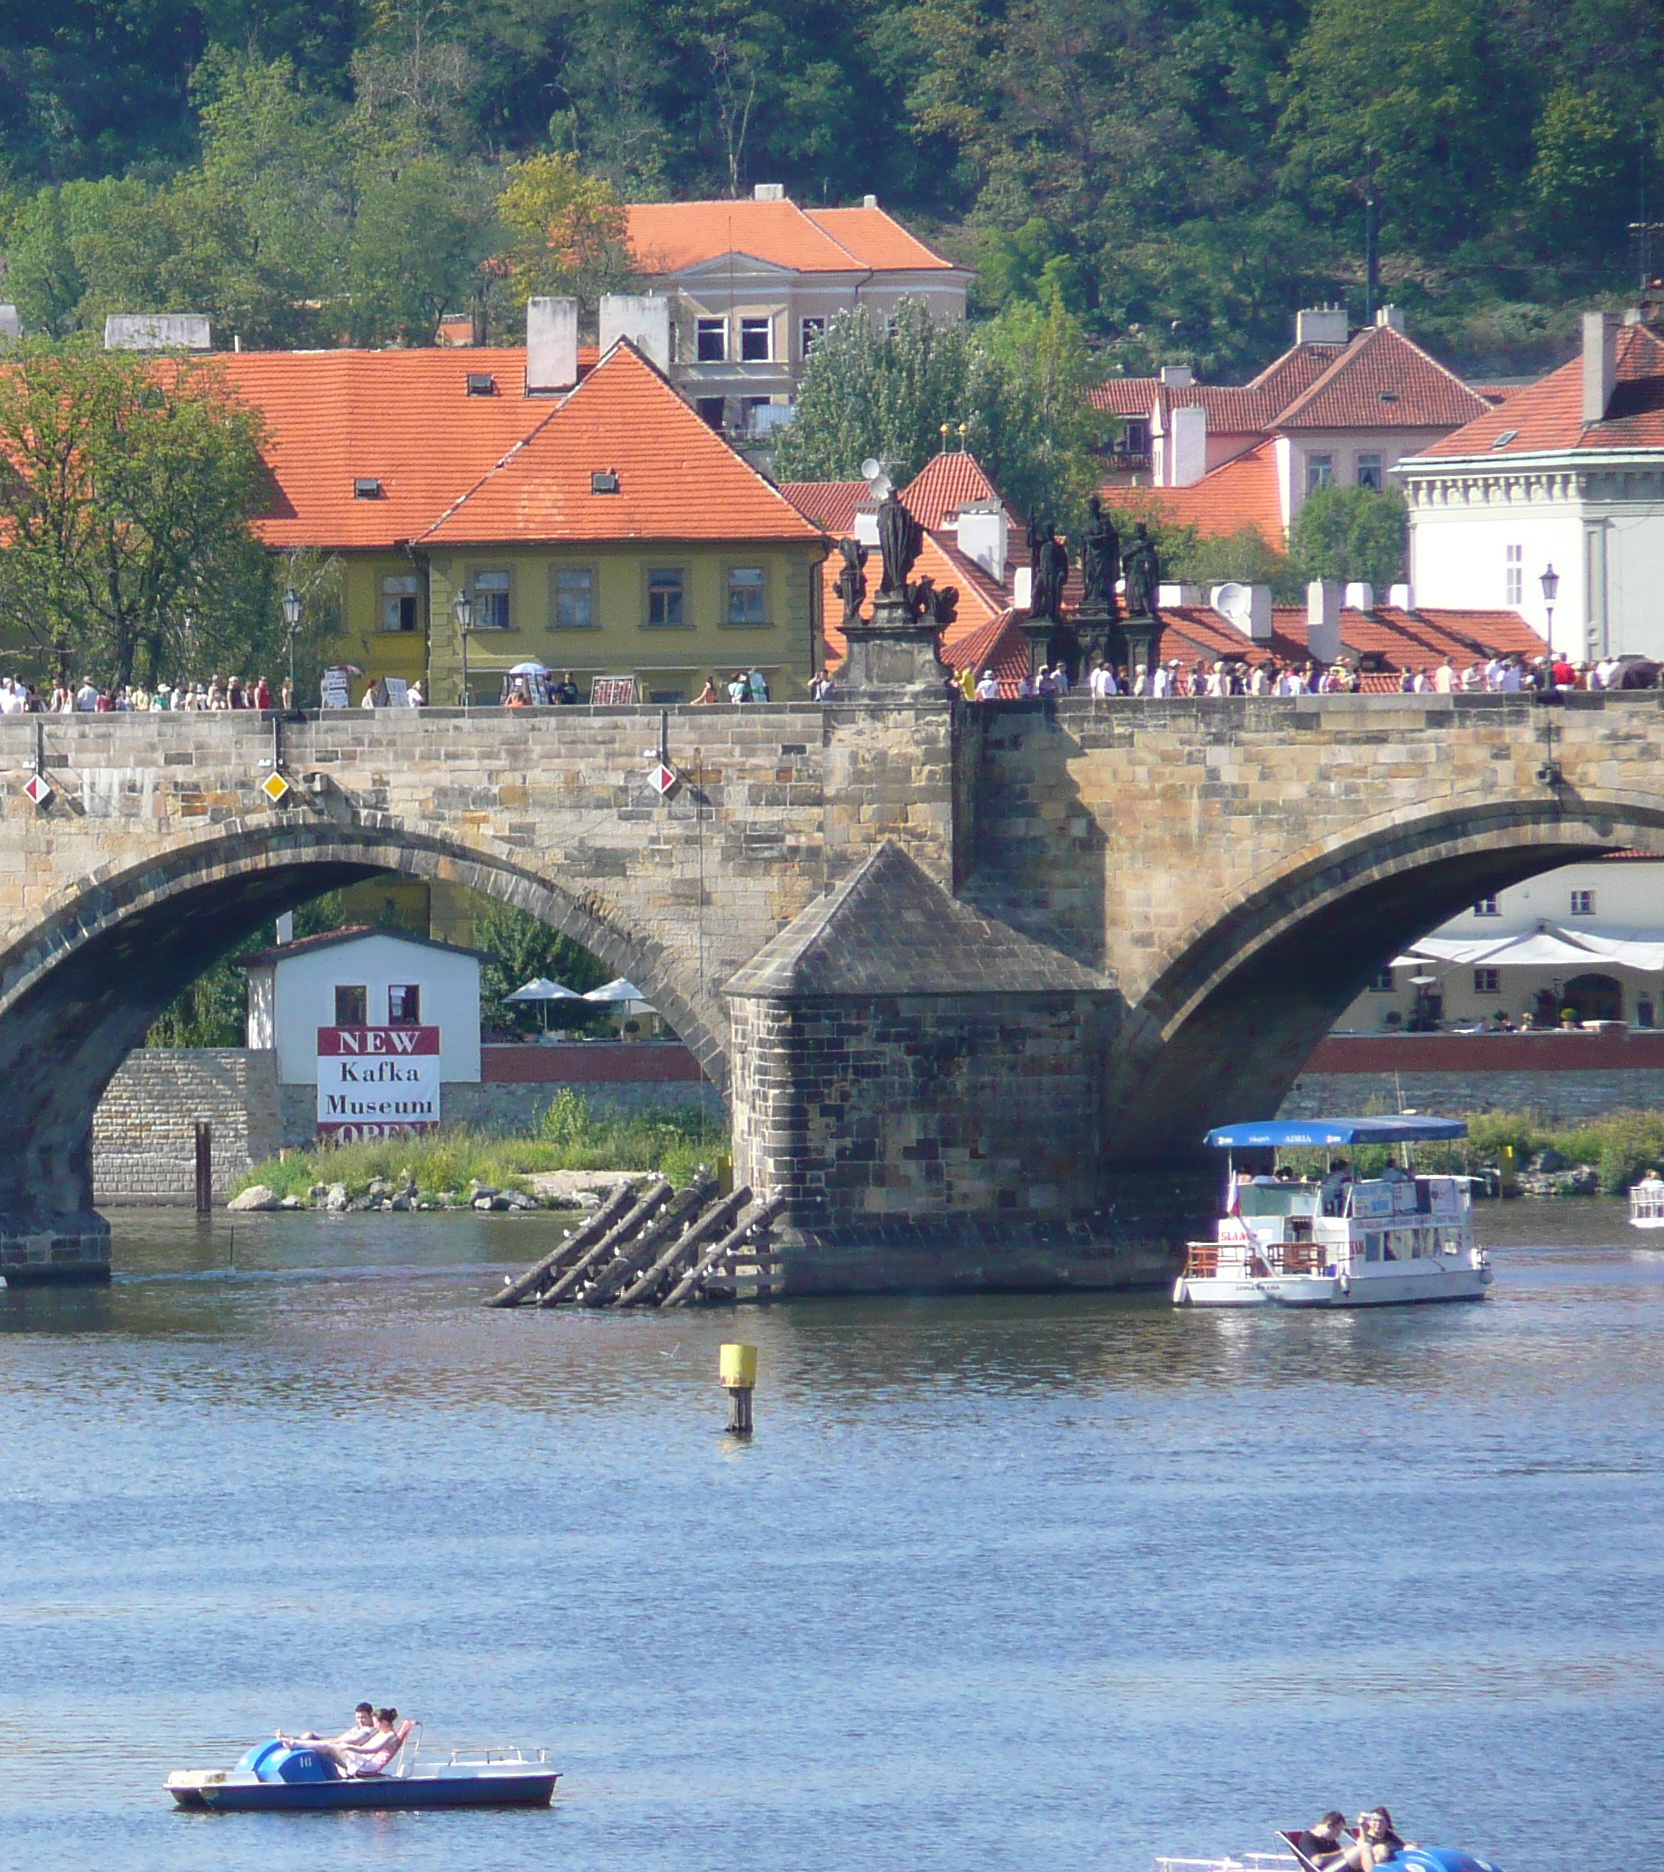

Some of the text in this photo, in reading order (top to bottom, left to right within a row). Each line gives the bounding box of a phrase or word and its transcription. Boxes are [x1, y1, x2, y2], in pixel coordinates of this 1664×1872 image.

[337, 1031, 421, 1054] NEW
[340, 1061, 420, 1082] Kafka
[325, 1094, 434, 1115] Museum
